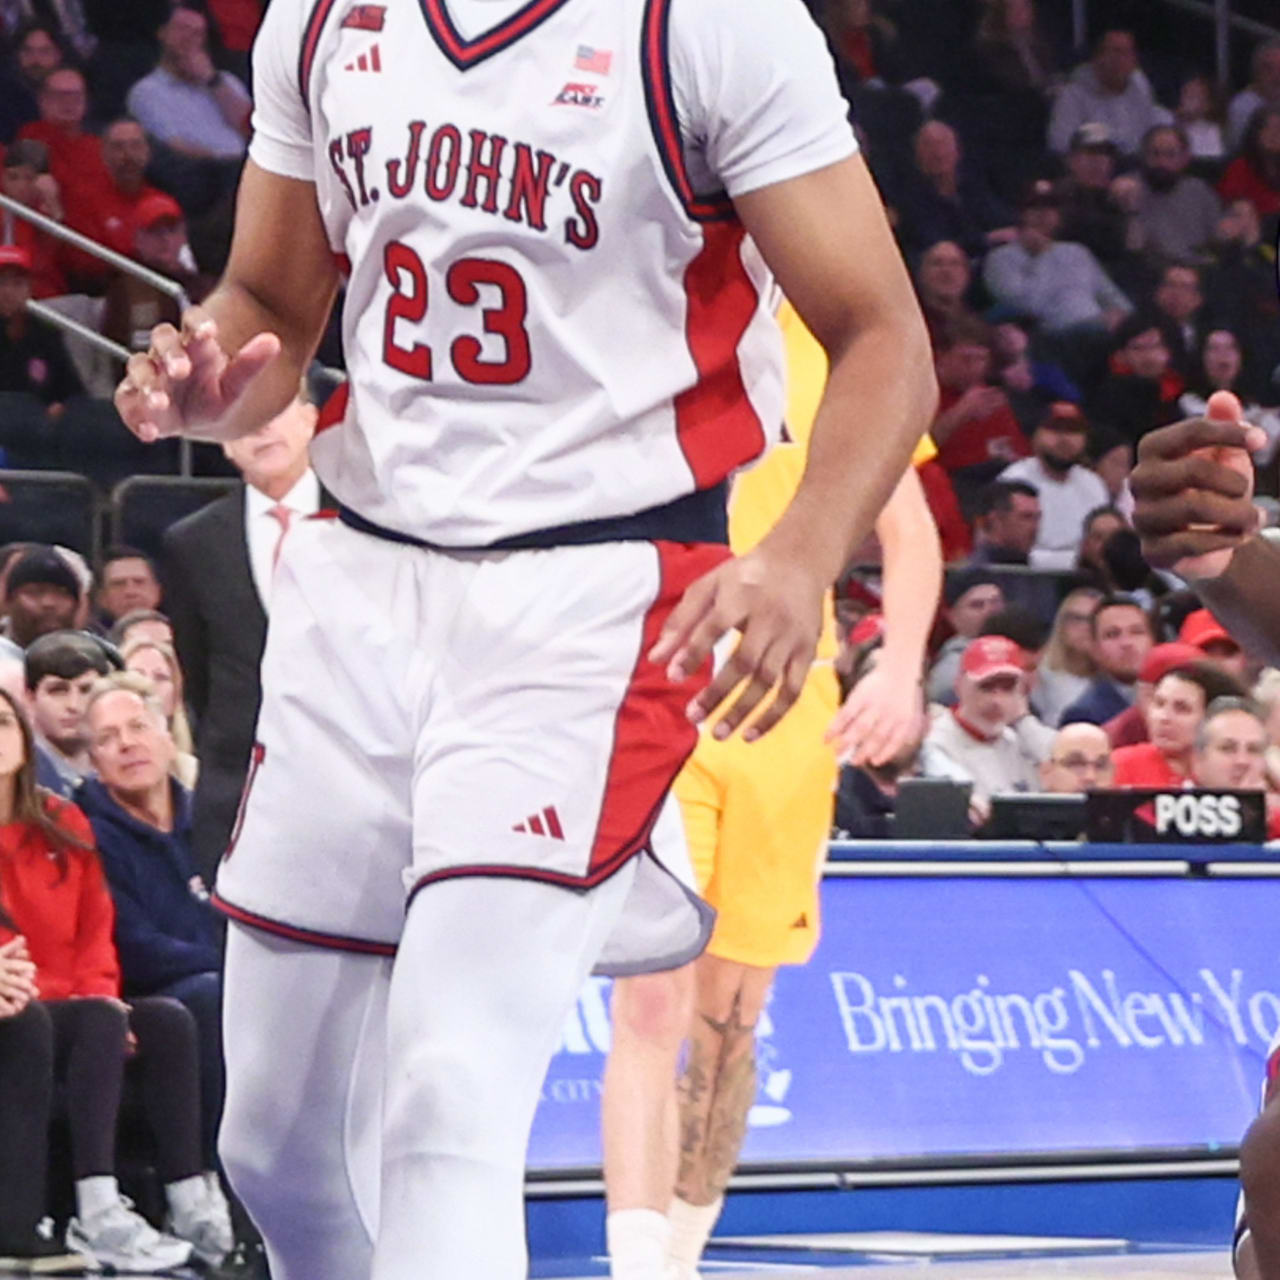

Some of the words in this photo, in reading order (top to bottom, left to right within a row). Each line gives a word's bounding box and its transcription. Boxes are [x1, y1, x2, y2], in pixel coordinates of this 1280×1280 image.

[329, 127, 380, 213] ST.
[385, 120, 604, 251] JOHN'S
[383, 240, 532, 386] 23
[1155, 794, 1241, 837] POSS
[830, 971, 1085, 1074] Bringing
[1069, 969, 1204, 1048] New
